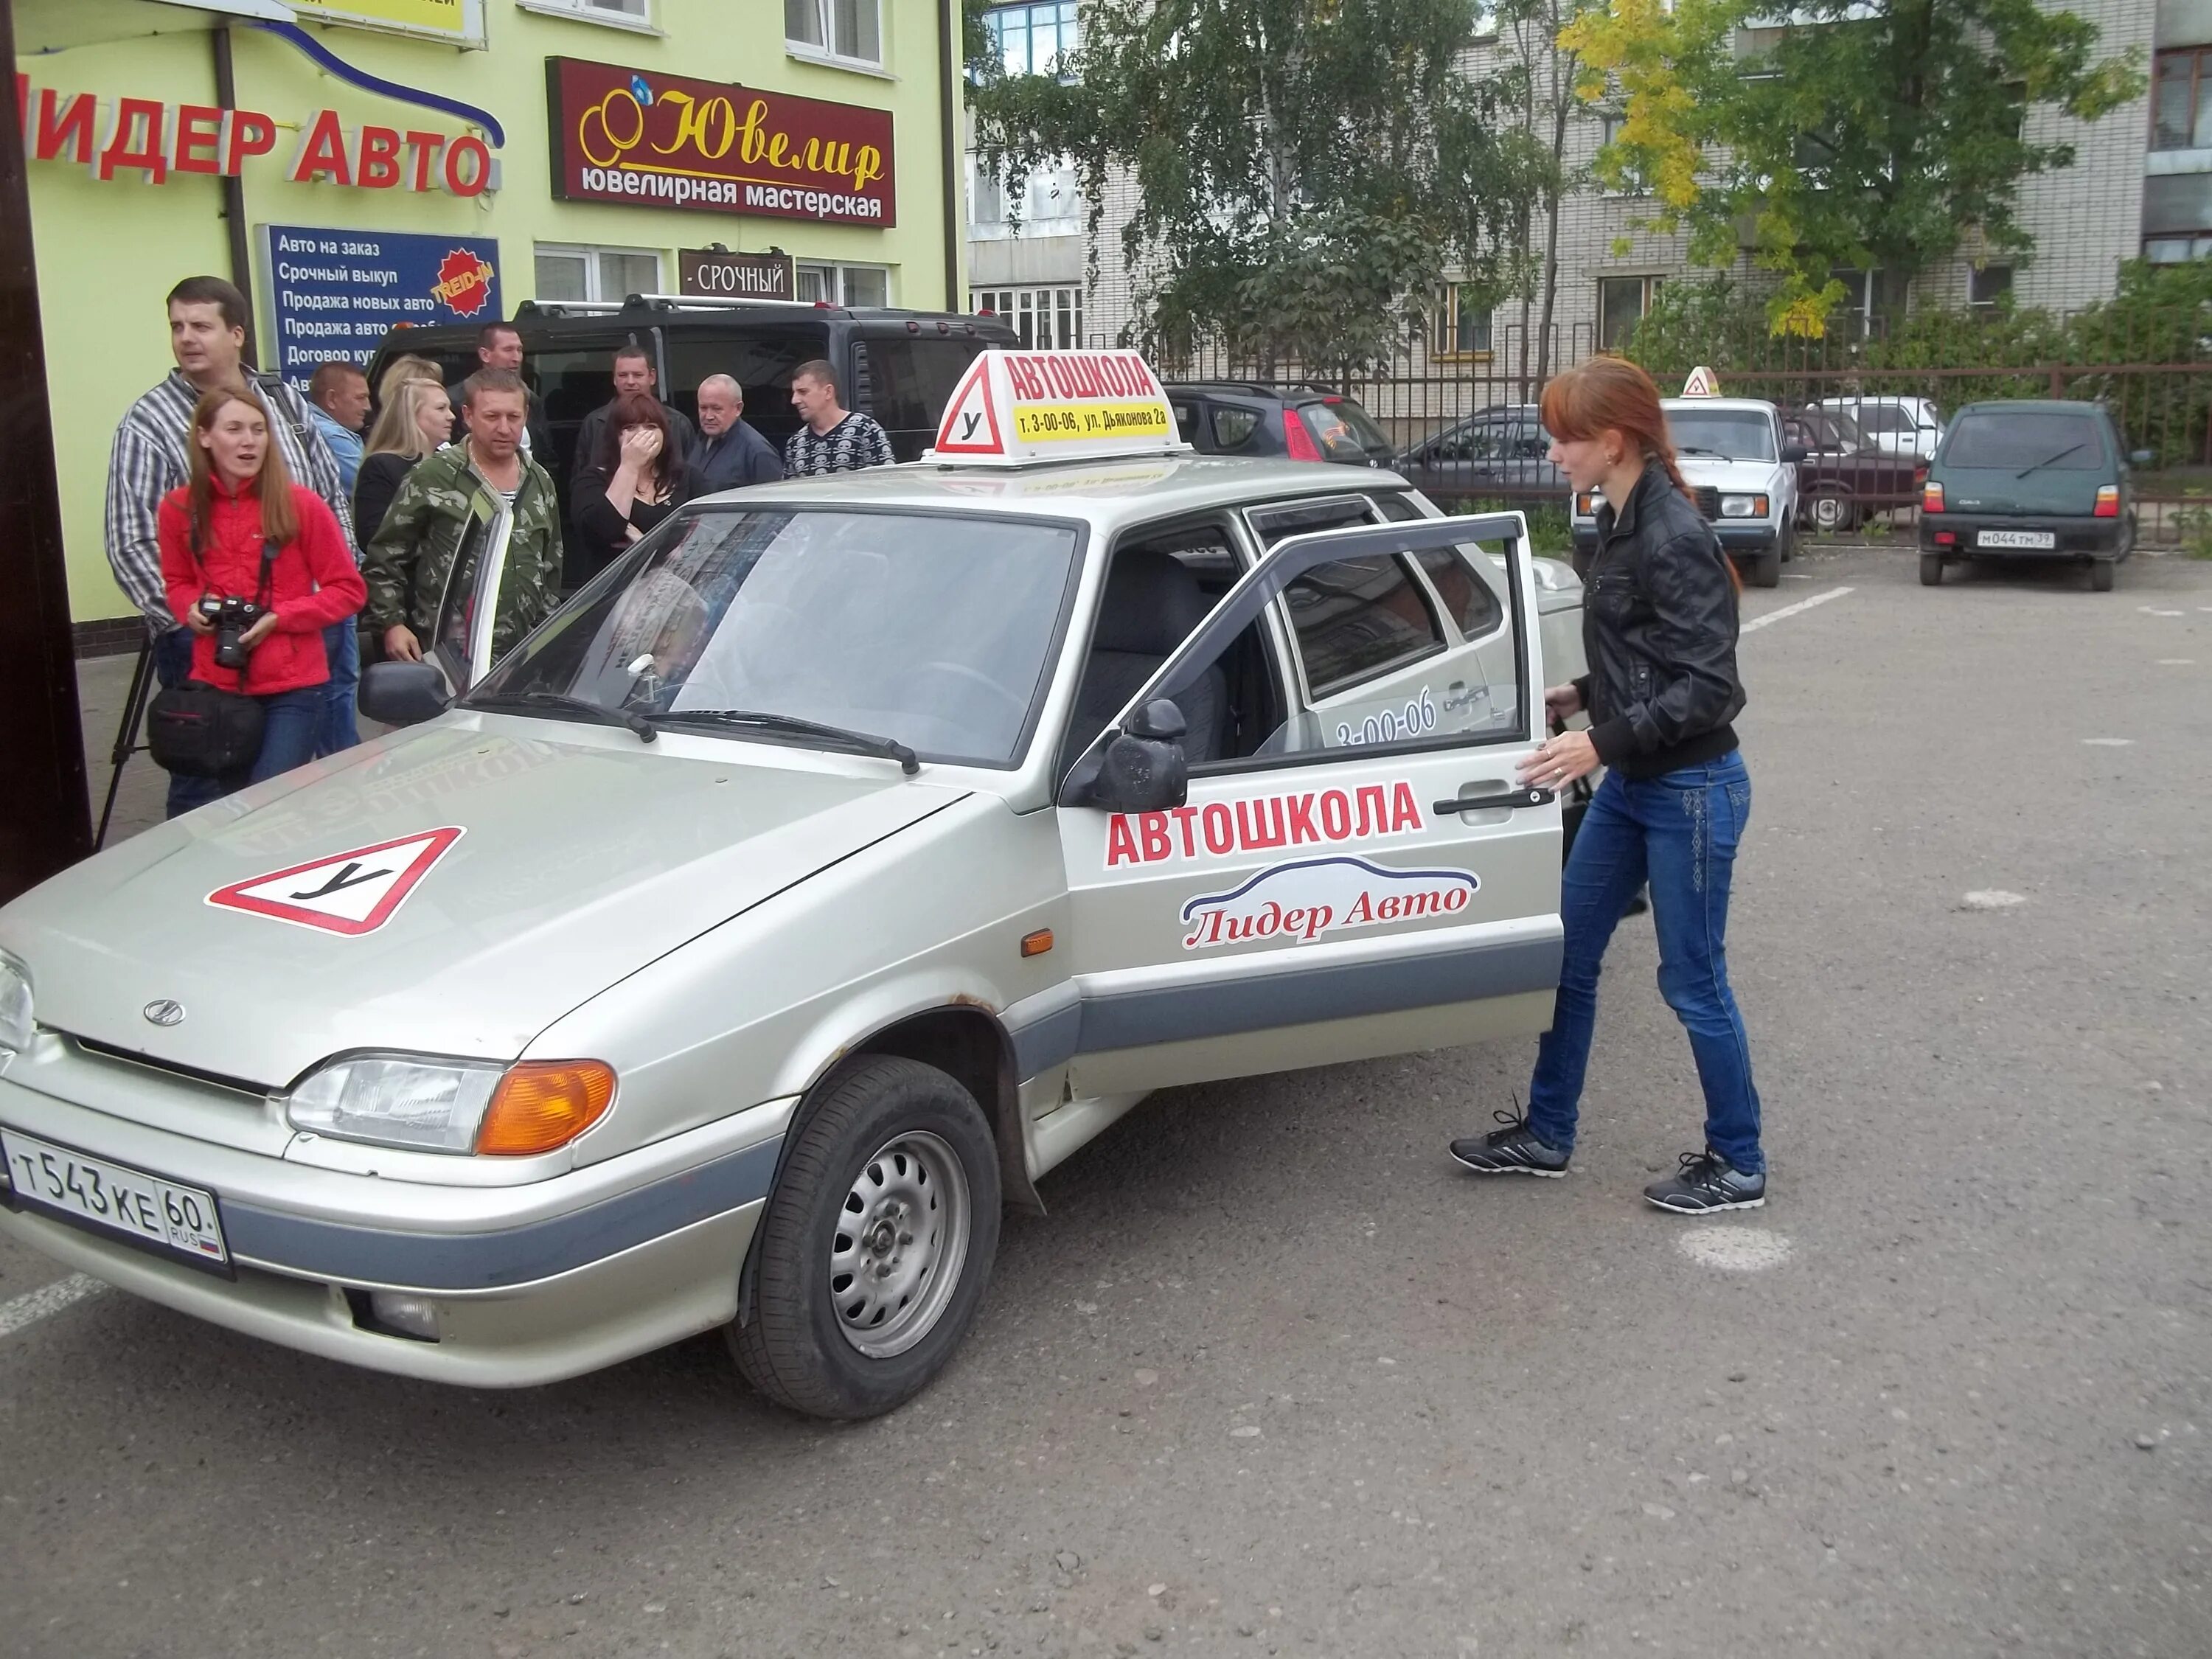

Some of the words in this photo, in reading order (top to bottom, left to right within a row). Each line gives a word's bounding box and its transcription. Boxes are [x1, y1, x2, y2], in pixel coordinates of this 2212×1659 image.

[13, 72, 276, 184] ИДЕР
[650, 91, 884, 190] Ювелир
[582, 167, 737, 206] ювелирная
[745, 184, 881, 218] мастерская
[279, 235, 316, 253] Авто
[321, 242, 337, 254] на
[341, 243, 380, 256] заказ
[279, 262, 348, 284] Срочный
[352, 269, 397, 287] выкуп
[430, 261, 495, 304] TREID-IN
[698, 264, 784, 293] СРОЧНЫЙ
[283, 291, 349, 311] Продажа
[353, 295, 400, 310] новых
[404, 297, 434, 311] авто
[285, 319, 352, 338] Продажа
[355, 323, 388, 335] авто
[290, 375, 312, 392] Ав
[1004, 355, 1156, 400] АВТОШКОЛА
[1020, 417, 1031, 434] т.
[1032, 412, 1080, 432] 3-00-06,
[1085, 414, 1101, 431] ул.
[1103, 410, 1153, 431] Дьяконова
[1153, 408, 1166, 425] 2а
[1107, 782, 1423, 866] АВТОШКОЛА
[1186, 901, 1334, 947] Лидер
[1344, 887, 1468, 925] Авто
[170, 1227, 199, 1247] RUS
